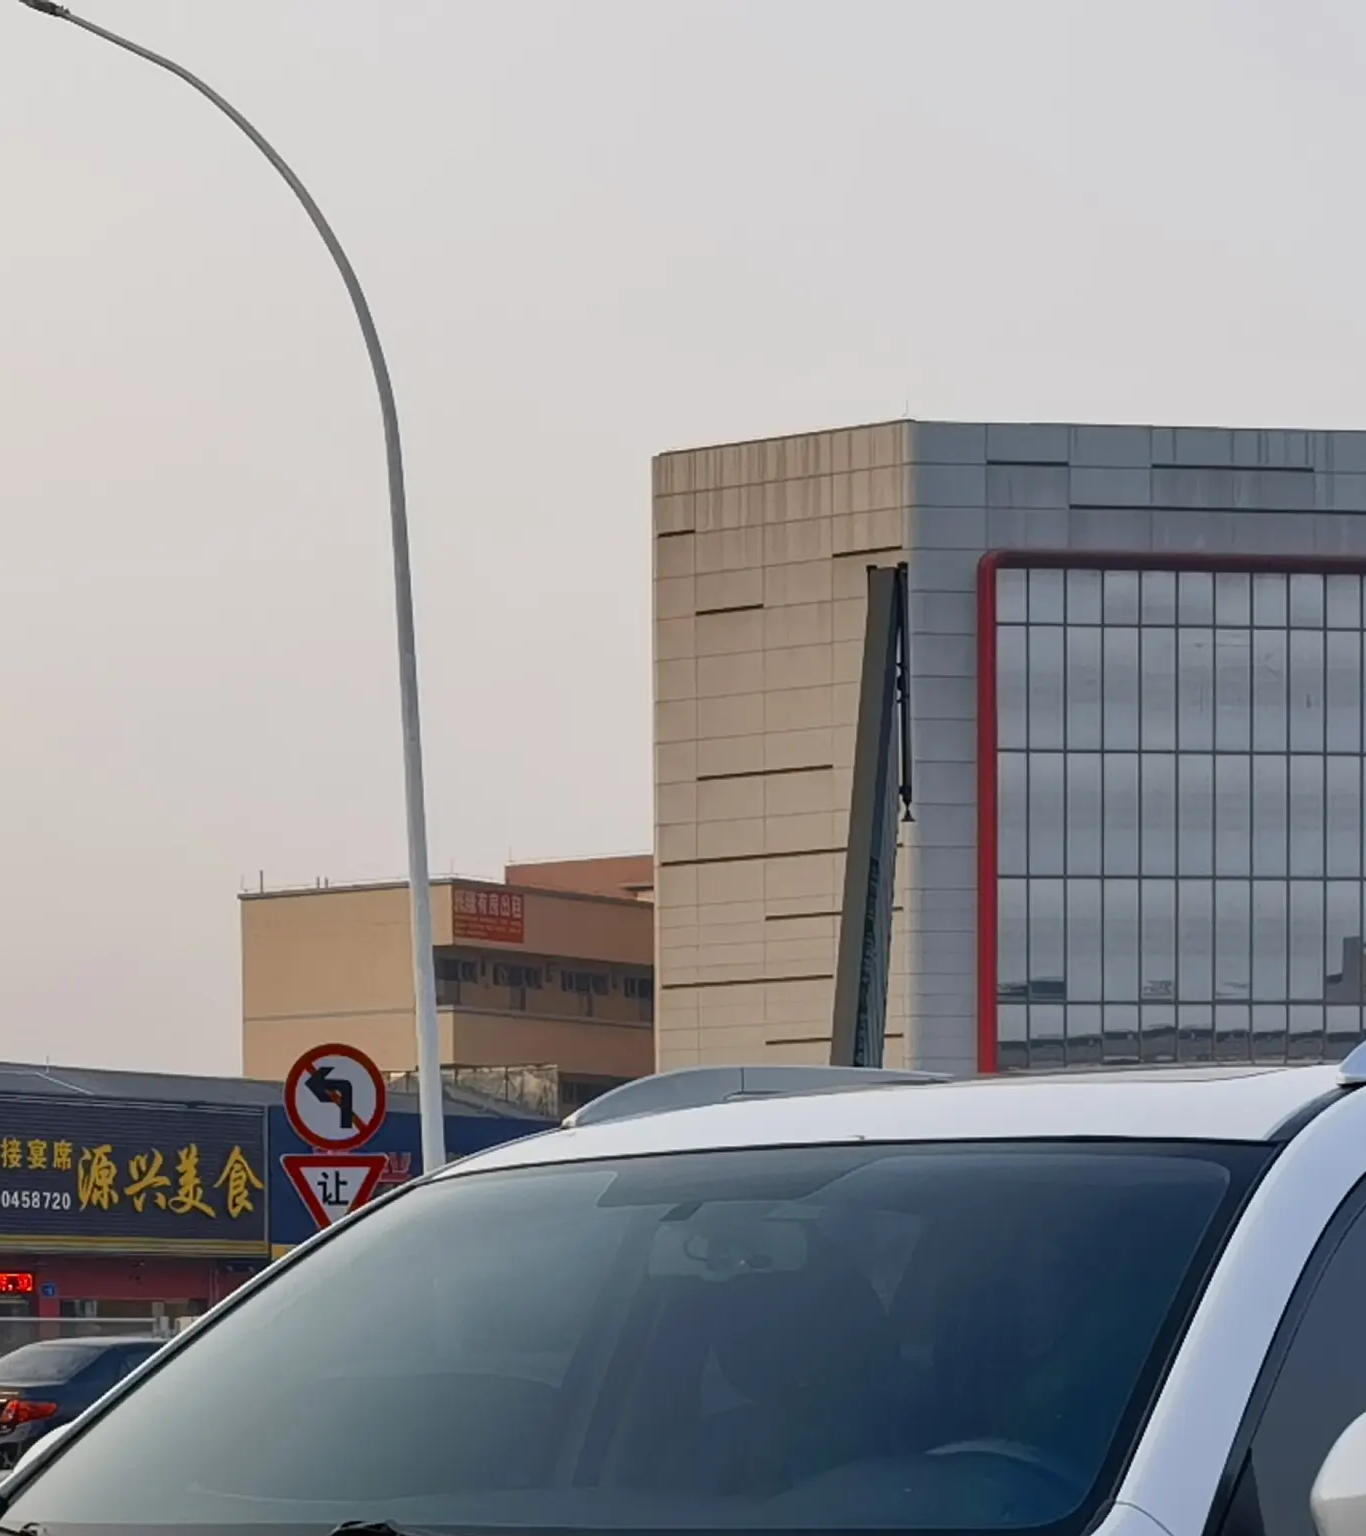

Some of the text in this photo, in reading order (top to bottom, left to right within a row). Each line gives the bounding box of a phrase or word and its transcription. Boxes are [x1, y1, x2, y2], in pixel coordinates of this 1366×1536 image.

[78, 1143, 264, 1219] 源兴美食
[317, 1171, 350, 1206] 让
